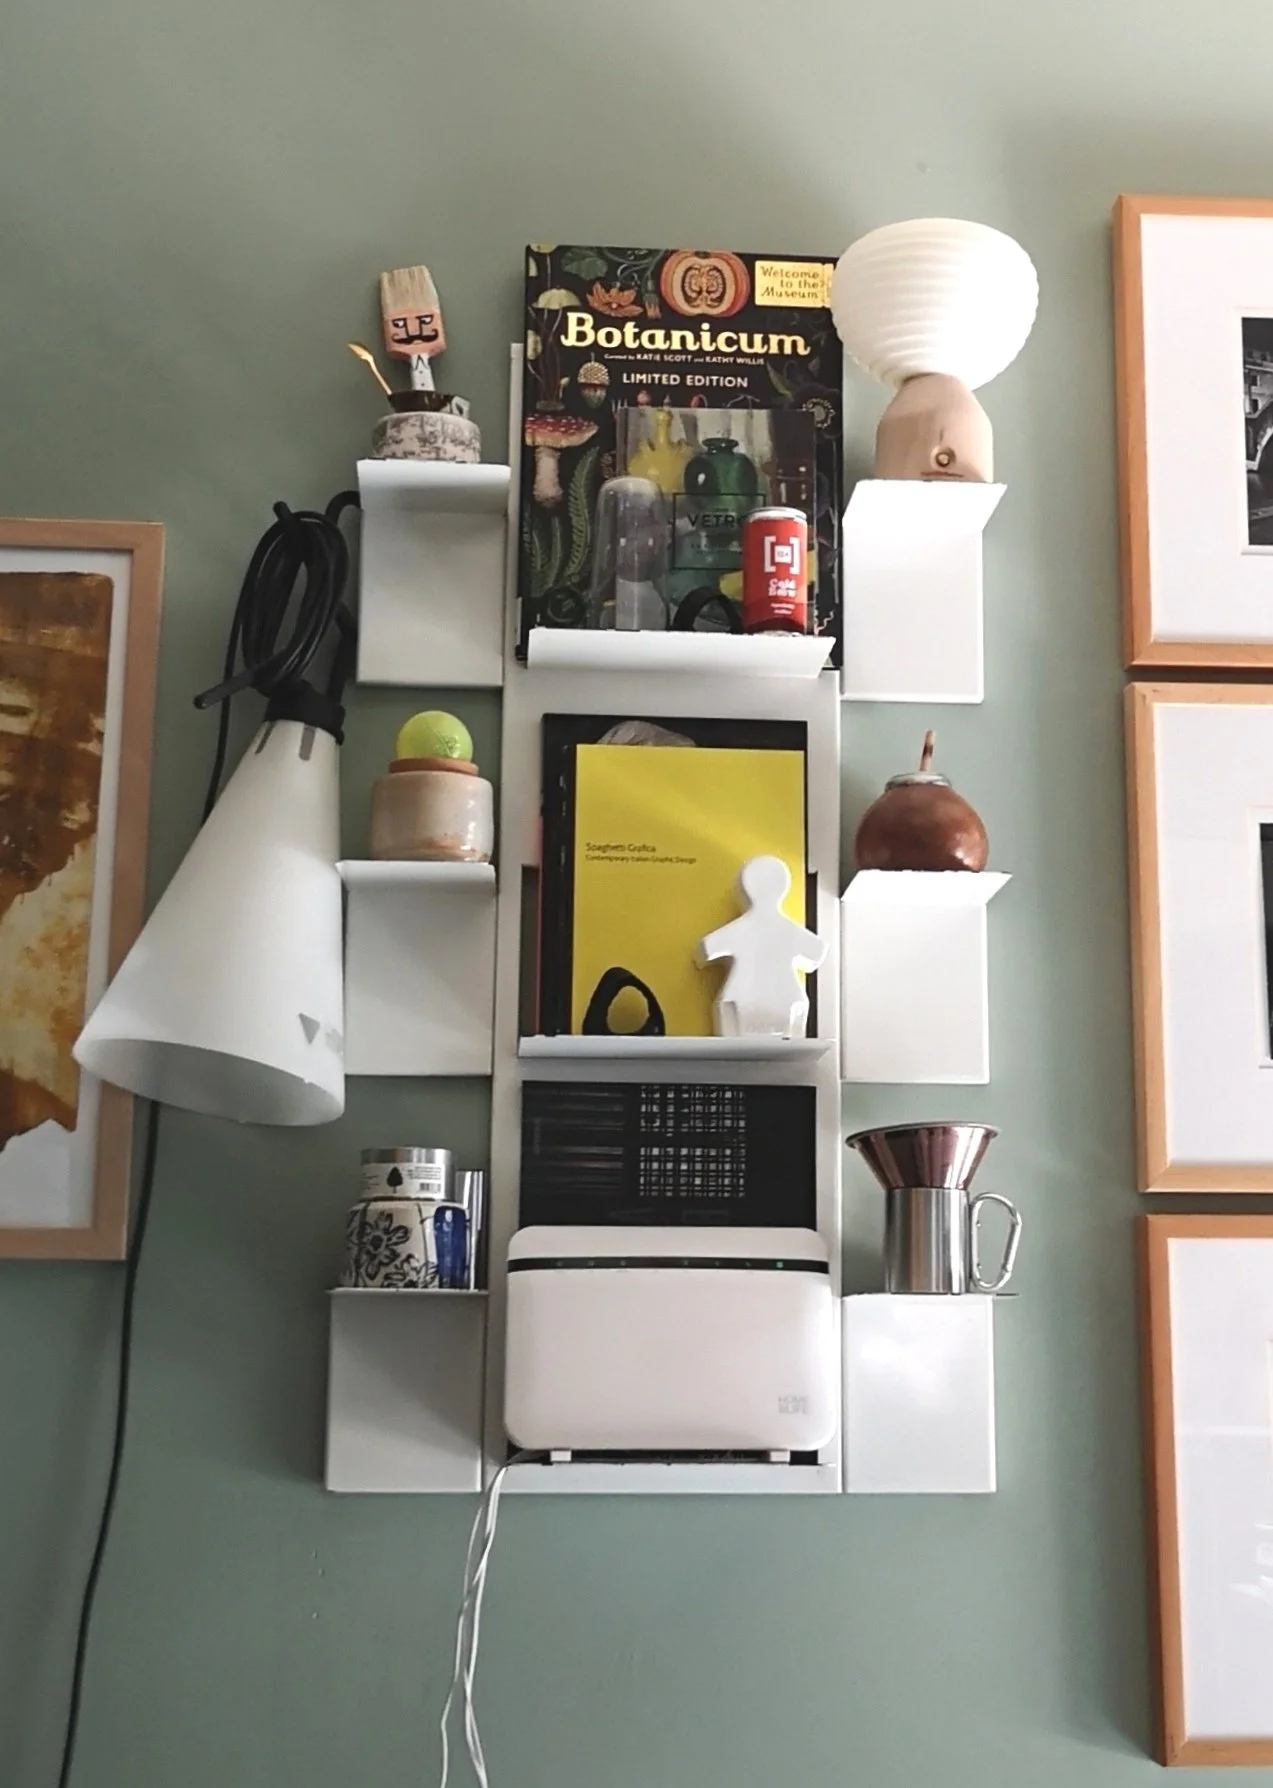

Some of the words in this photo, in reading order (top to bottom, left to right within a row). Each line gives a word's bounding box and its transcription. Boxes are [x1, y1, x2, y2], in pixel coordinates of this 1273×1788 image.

[760, 265, 820, 279] Welcome
[780, 279, 793, 288] to
[798, 280, 819, 289] the
[761, 285, 819, 299] Museum
[560, 312, 811, 355] Botanicum
[636, 353, 660, 361] KATIE
[663, 354, 692, 362] SCOTT
[705, 355, 734, 363] KATHY
[736, 356, 764, 365] WILLIS
[622, 372, 680, 385] LIMITED
[686, 375, 748, 388] EDITION
[585, 842, 625, 853] Spaghetti
